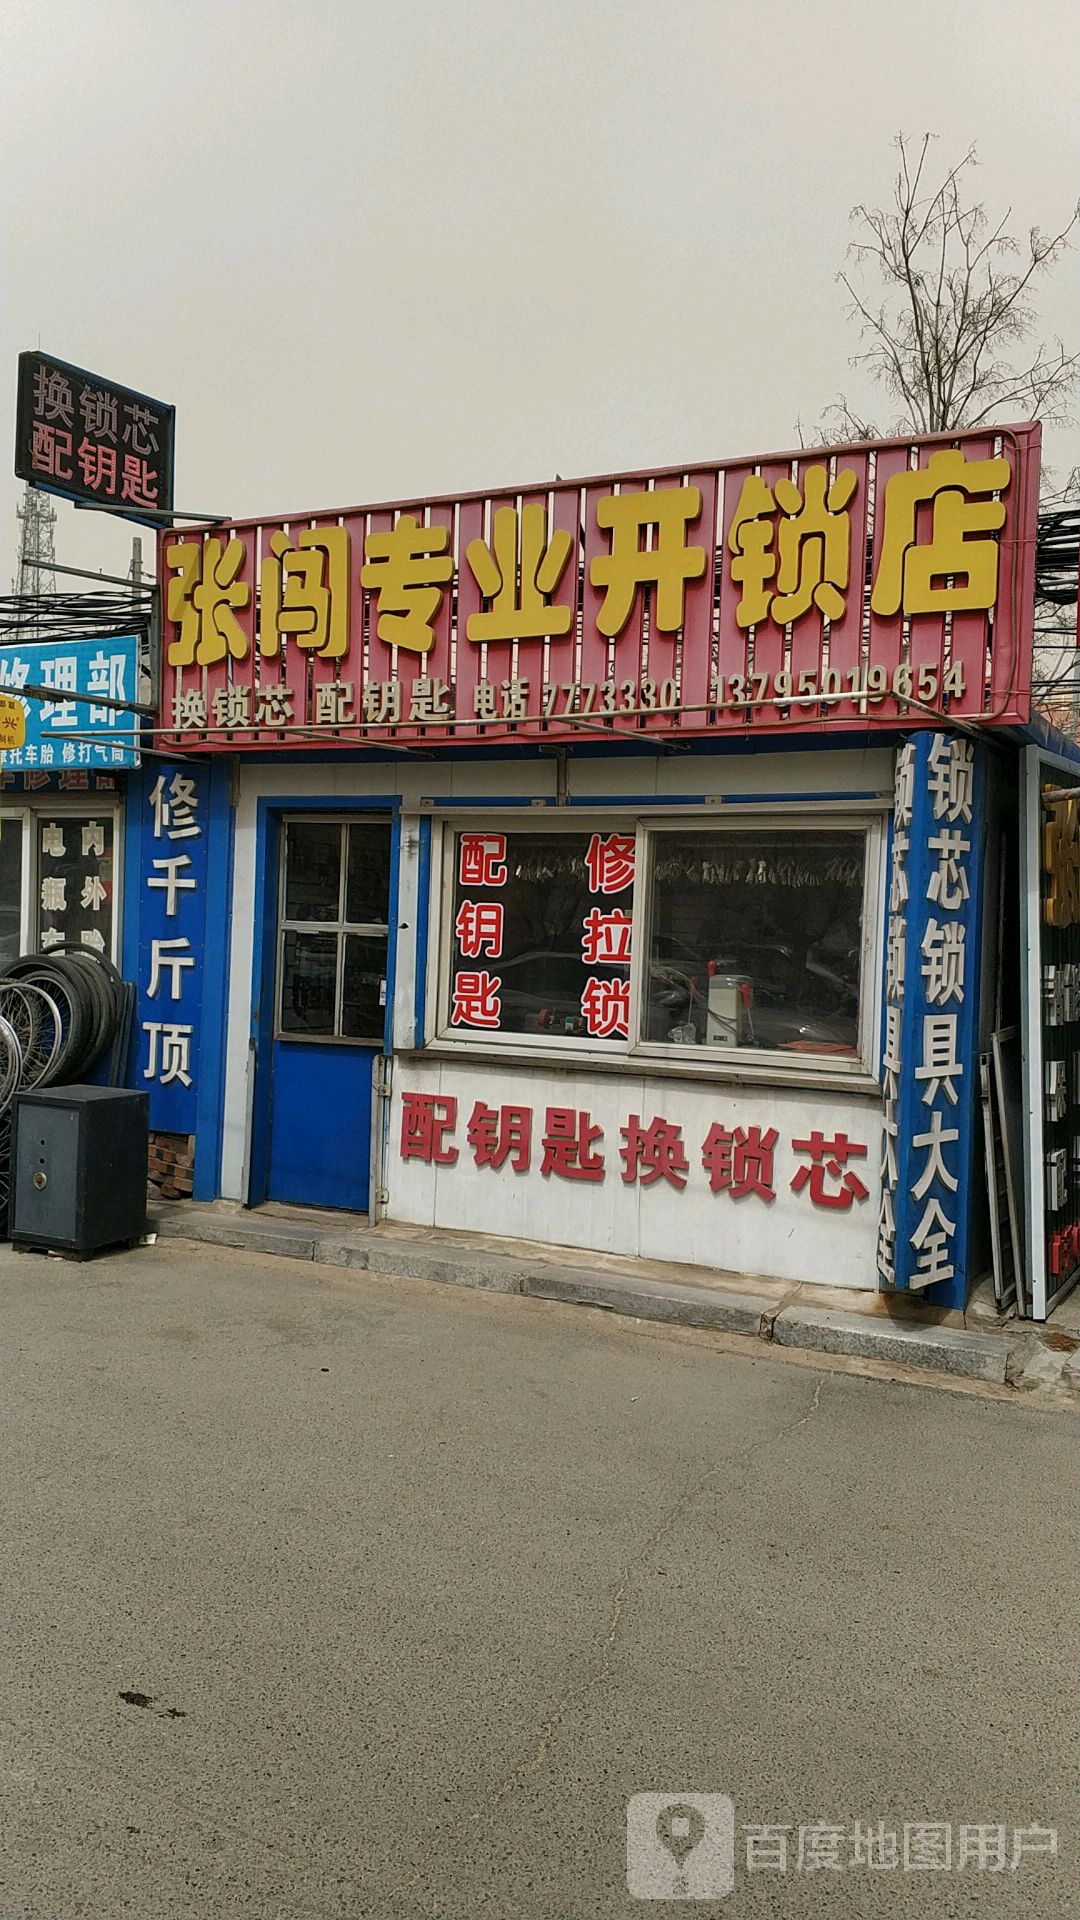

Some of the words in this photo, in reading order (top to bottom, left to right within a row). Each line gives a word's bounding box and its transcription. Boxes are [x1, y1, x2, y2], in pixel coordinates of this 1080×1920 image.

[32, 420, 158, 510] 配钥匙
[33, 365, 159, 456] 换锁芯
[167, 448, 1011, 667] 张闯专业开锁店
[62, 739, 125, 764] 修打气筒
[171, 684, 294, 729] 换锁芯
[315, 677, 451, 724] 配钥匙
[474, 677, 531, 720] 电话
[543, 676, 678, 718] 7773330
[713, 660, 967, 711] 13795019654
[142, 773, 202, 1088] 修千斤顶
[451, 832, 508, 1028] 配钥匙
[581, 832, 636, 1039] 修拉锁
[908, 732, 975, 1290] 锁芯锁具大全
[400, 1091, 871, 1209] 配钥匙换锁芯
